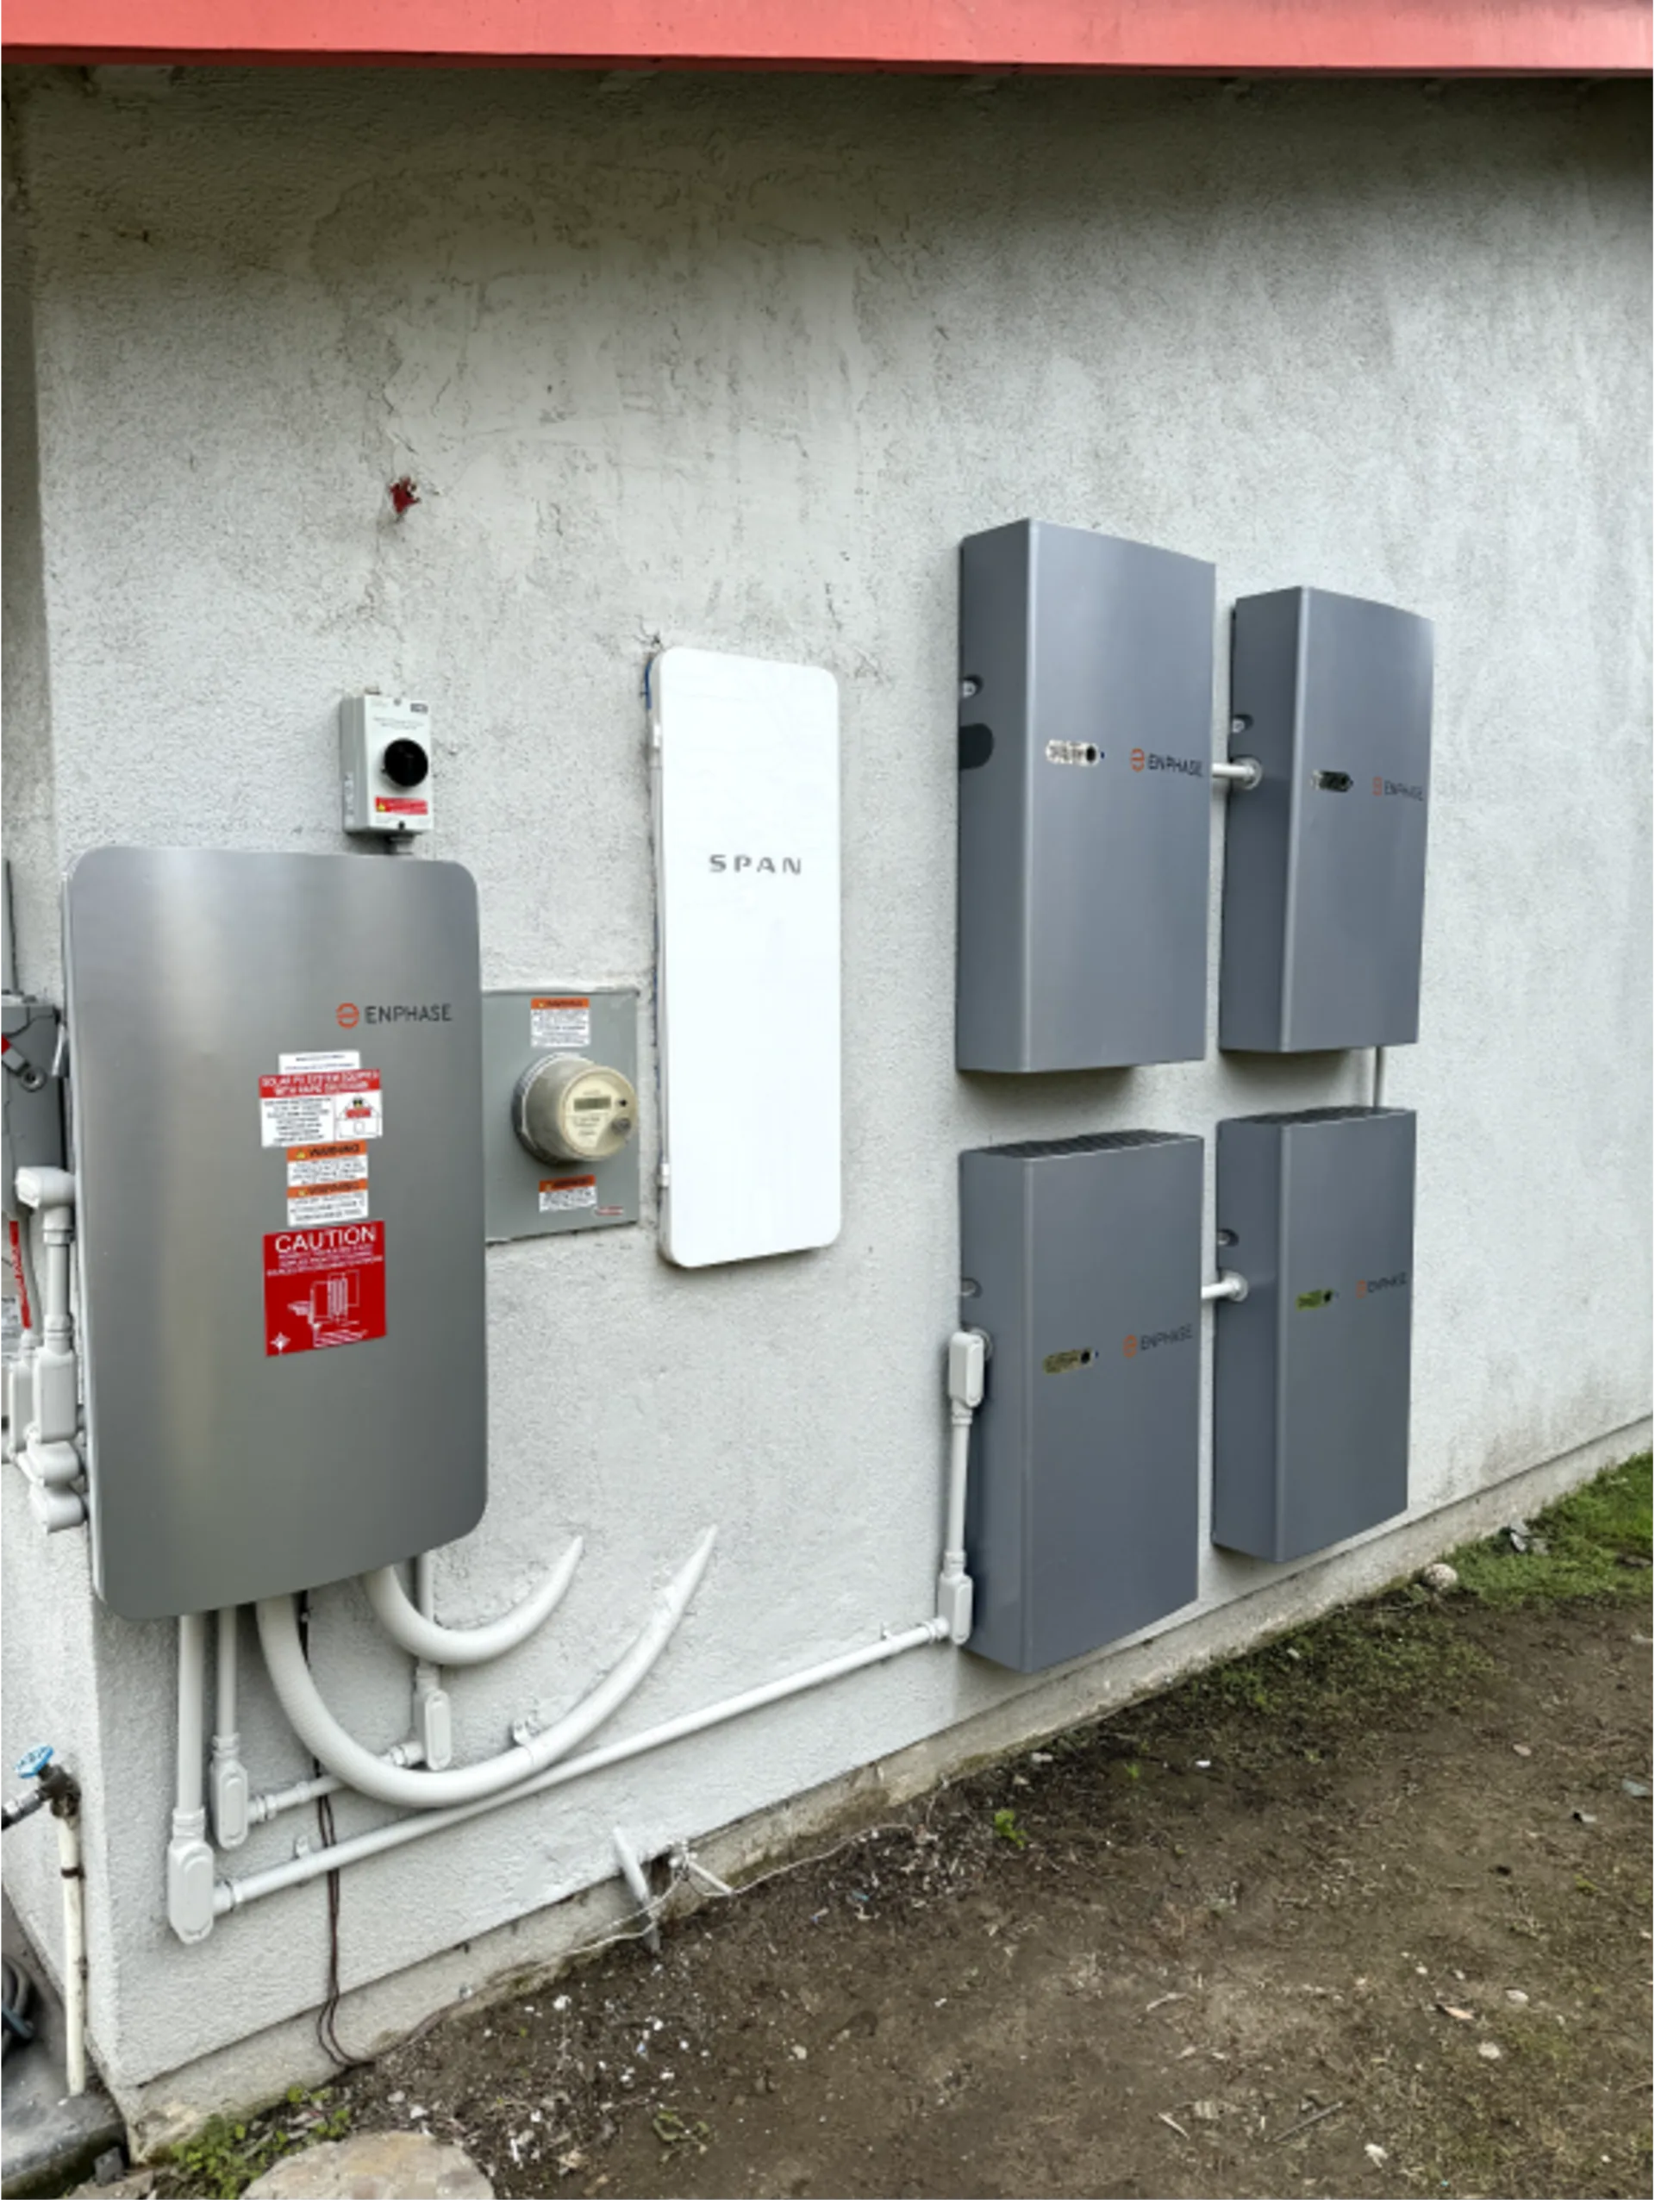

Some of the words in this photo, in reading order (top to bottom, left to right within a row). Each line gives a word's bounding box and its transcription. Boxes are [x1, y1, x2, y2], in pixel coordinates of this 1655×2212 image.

[1147, 753, 1204, 777] ENPHASE
[709, 853, 802, 875] SPAN
[365, 1003, 453, 1025] ENPHASE
[275, 1226, 377, 1253] CAUTION
